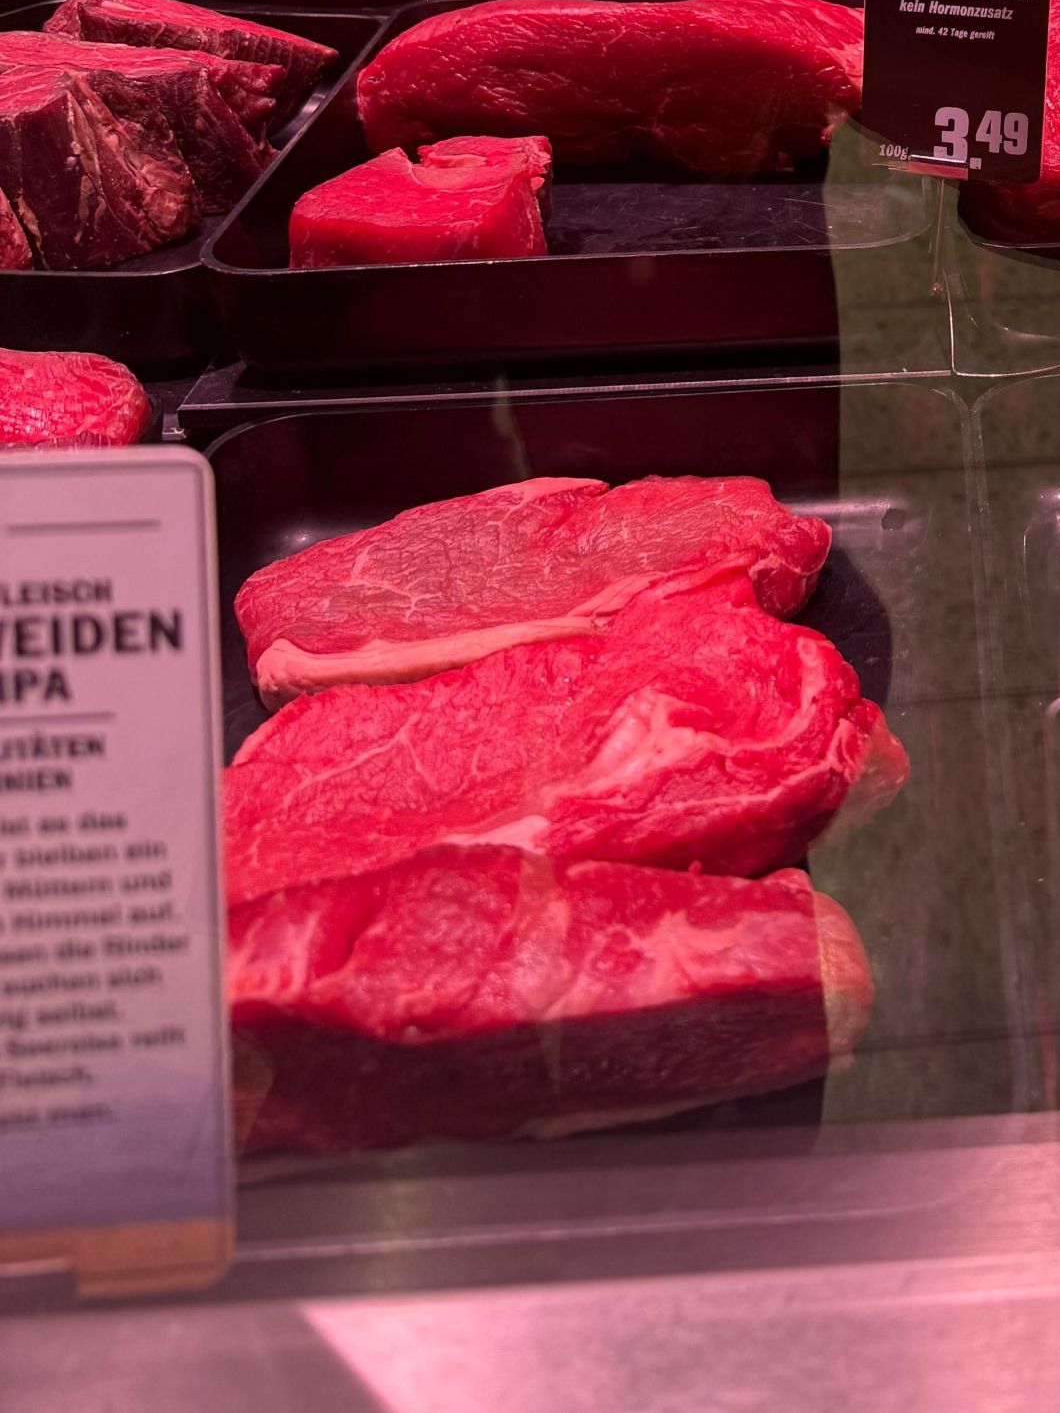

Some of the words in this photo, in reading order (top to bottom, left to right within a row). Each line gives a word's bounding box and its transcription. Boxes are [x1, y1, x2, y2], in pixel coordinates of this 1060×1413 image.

[928, 0, 1013, 20] Hormonzusatz
[938, 27, 948, 36] 42
[950, 27, 968, 39] Tage
[969, 29, 996, 40] gereift
[933, 106, 1029, 170] 3.49
[879, 144, 909, 161] 100g
[0, 577, 112, 606] LEISCH
